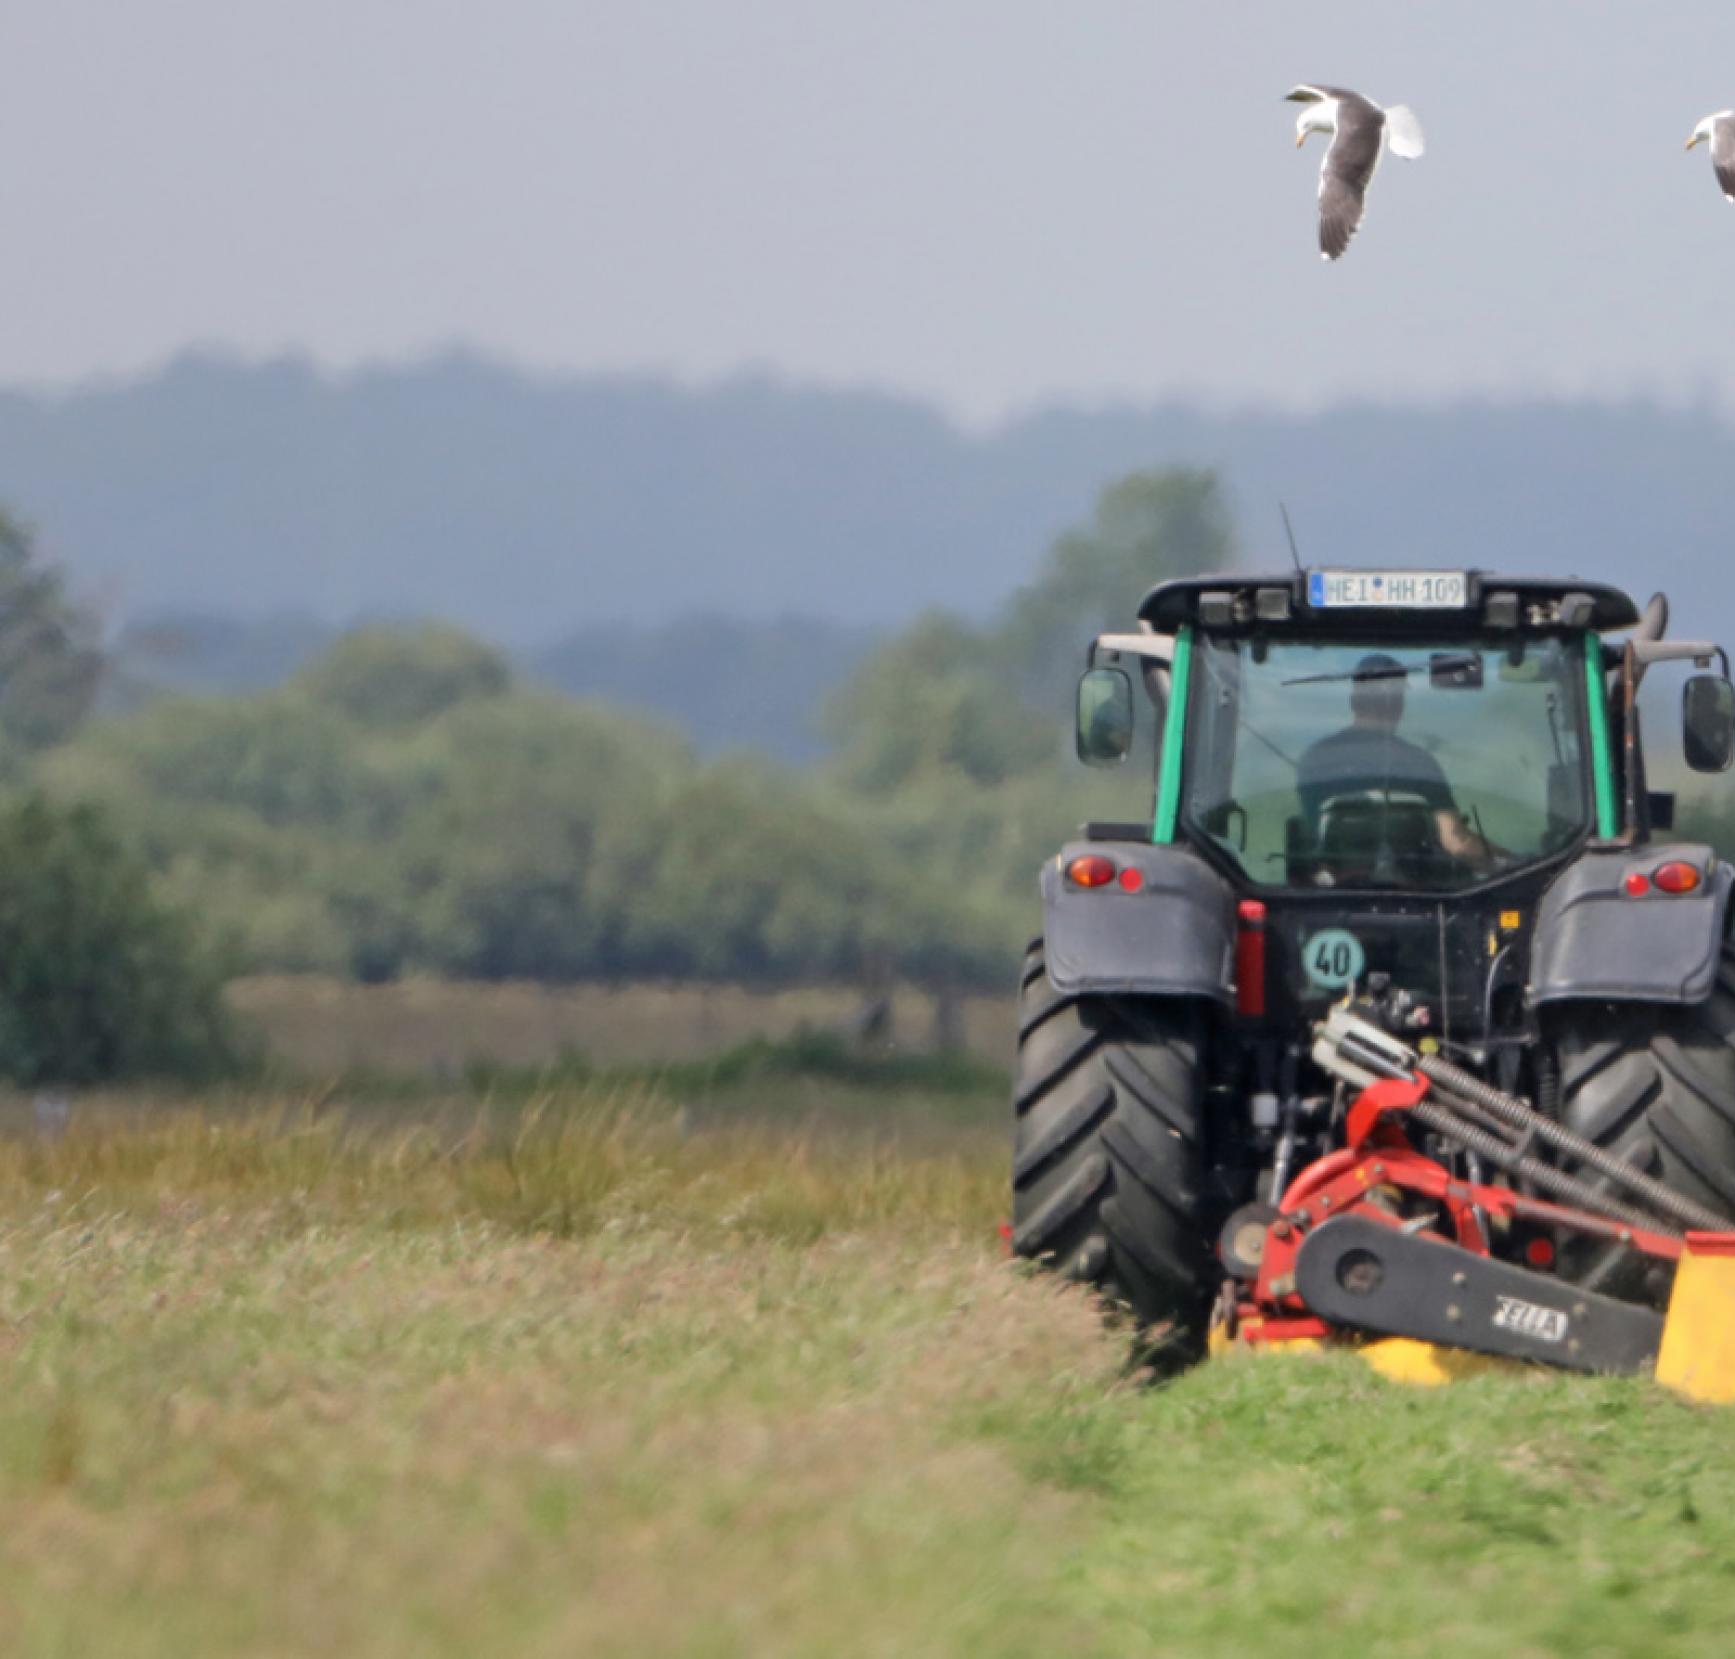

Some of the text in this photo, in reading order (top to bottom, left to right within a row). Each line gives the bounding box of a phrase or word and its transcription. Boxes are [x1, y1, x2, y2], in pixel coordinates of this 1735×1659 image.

[1326, 577, 1462, 602] HEI HH 109
[1315, 941, 1351, 977] 40
